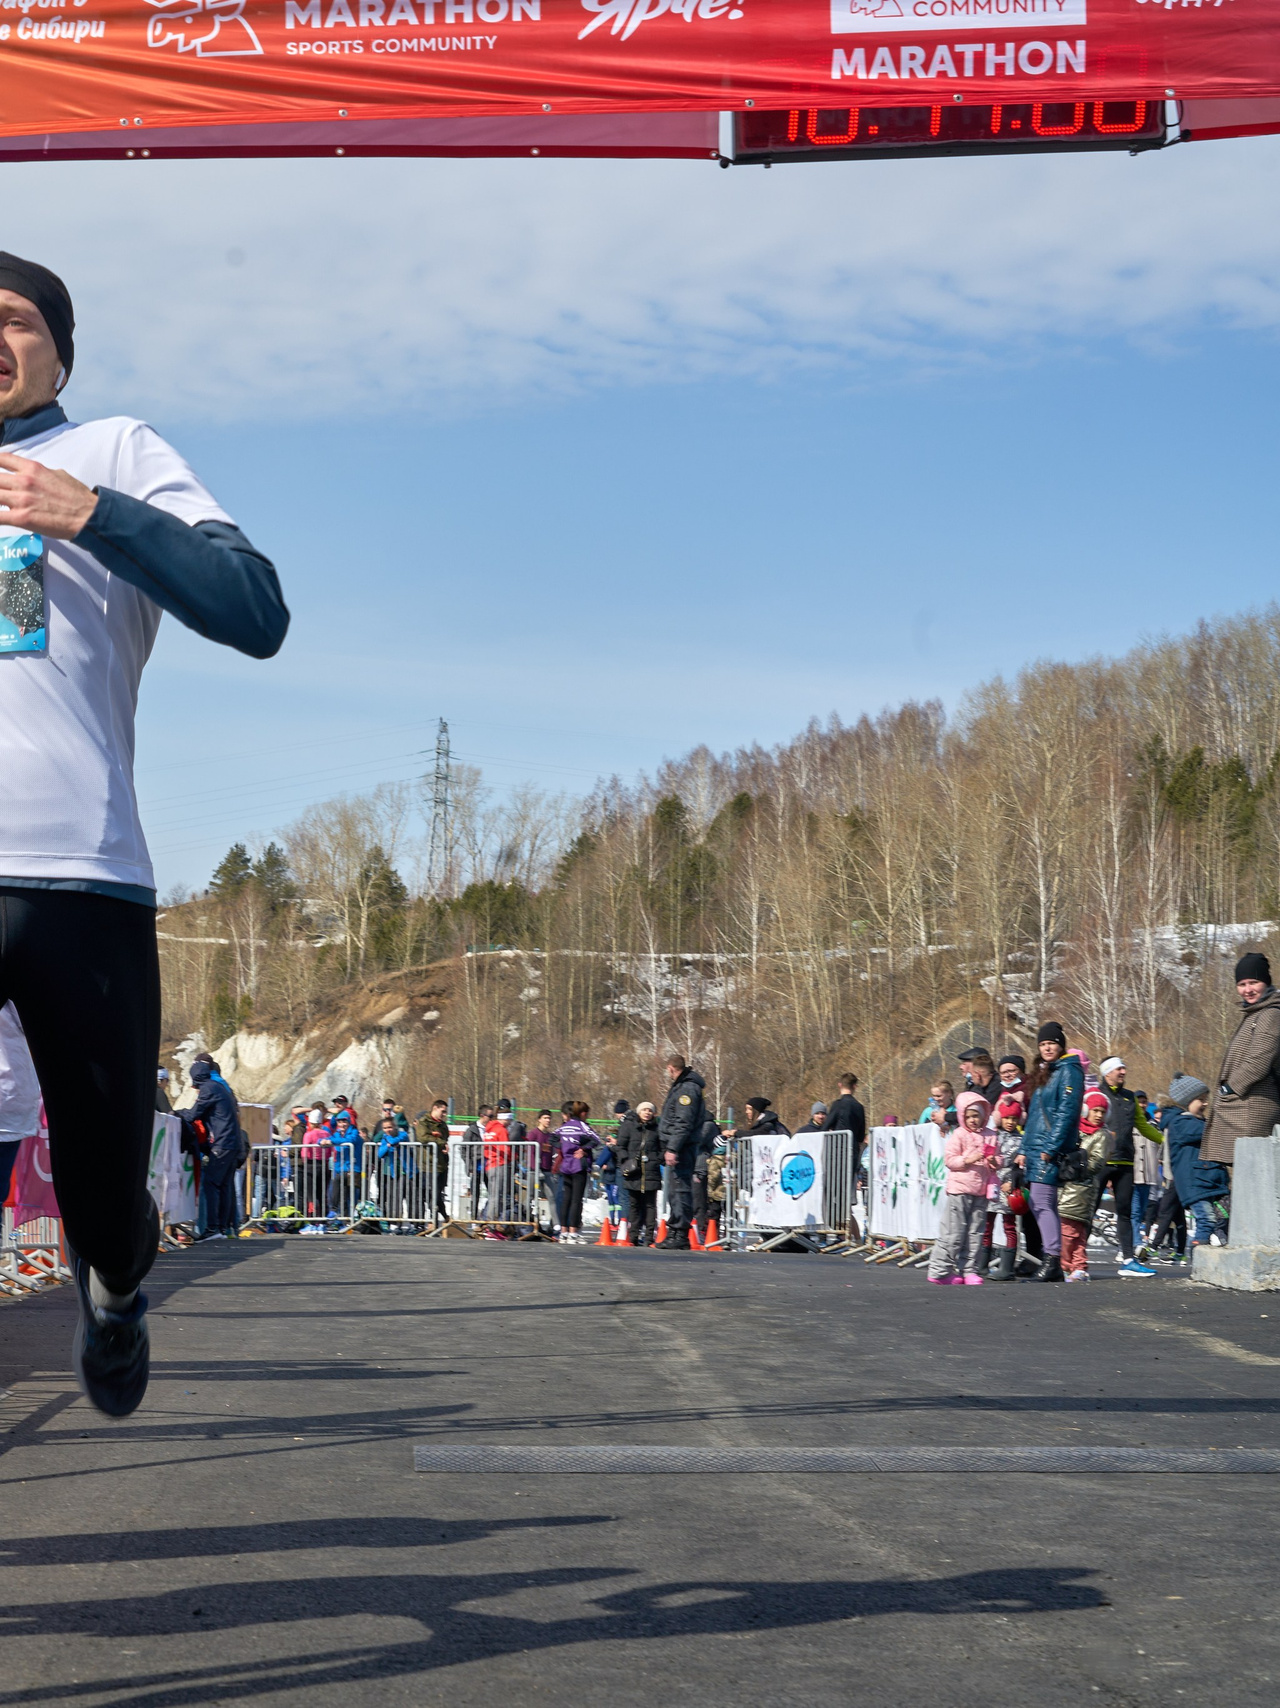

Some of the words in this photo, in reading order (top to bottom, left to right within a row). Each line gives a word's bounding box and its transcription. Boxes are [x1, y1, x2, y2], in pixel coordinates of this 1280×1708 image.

[285, 0, 541, 29] MARATHON
[913, 0, 1066, 17] COMMUNITY
[17, 15, 106, 44] Сибири
[286, 40, 365, 55] SPORTS
[371, 35, 498, 53] COMMUNITY
[831, 40, 1087, 80] MARATHON
